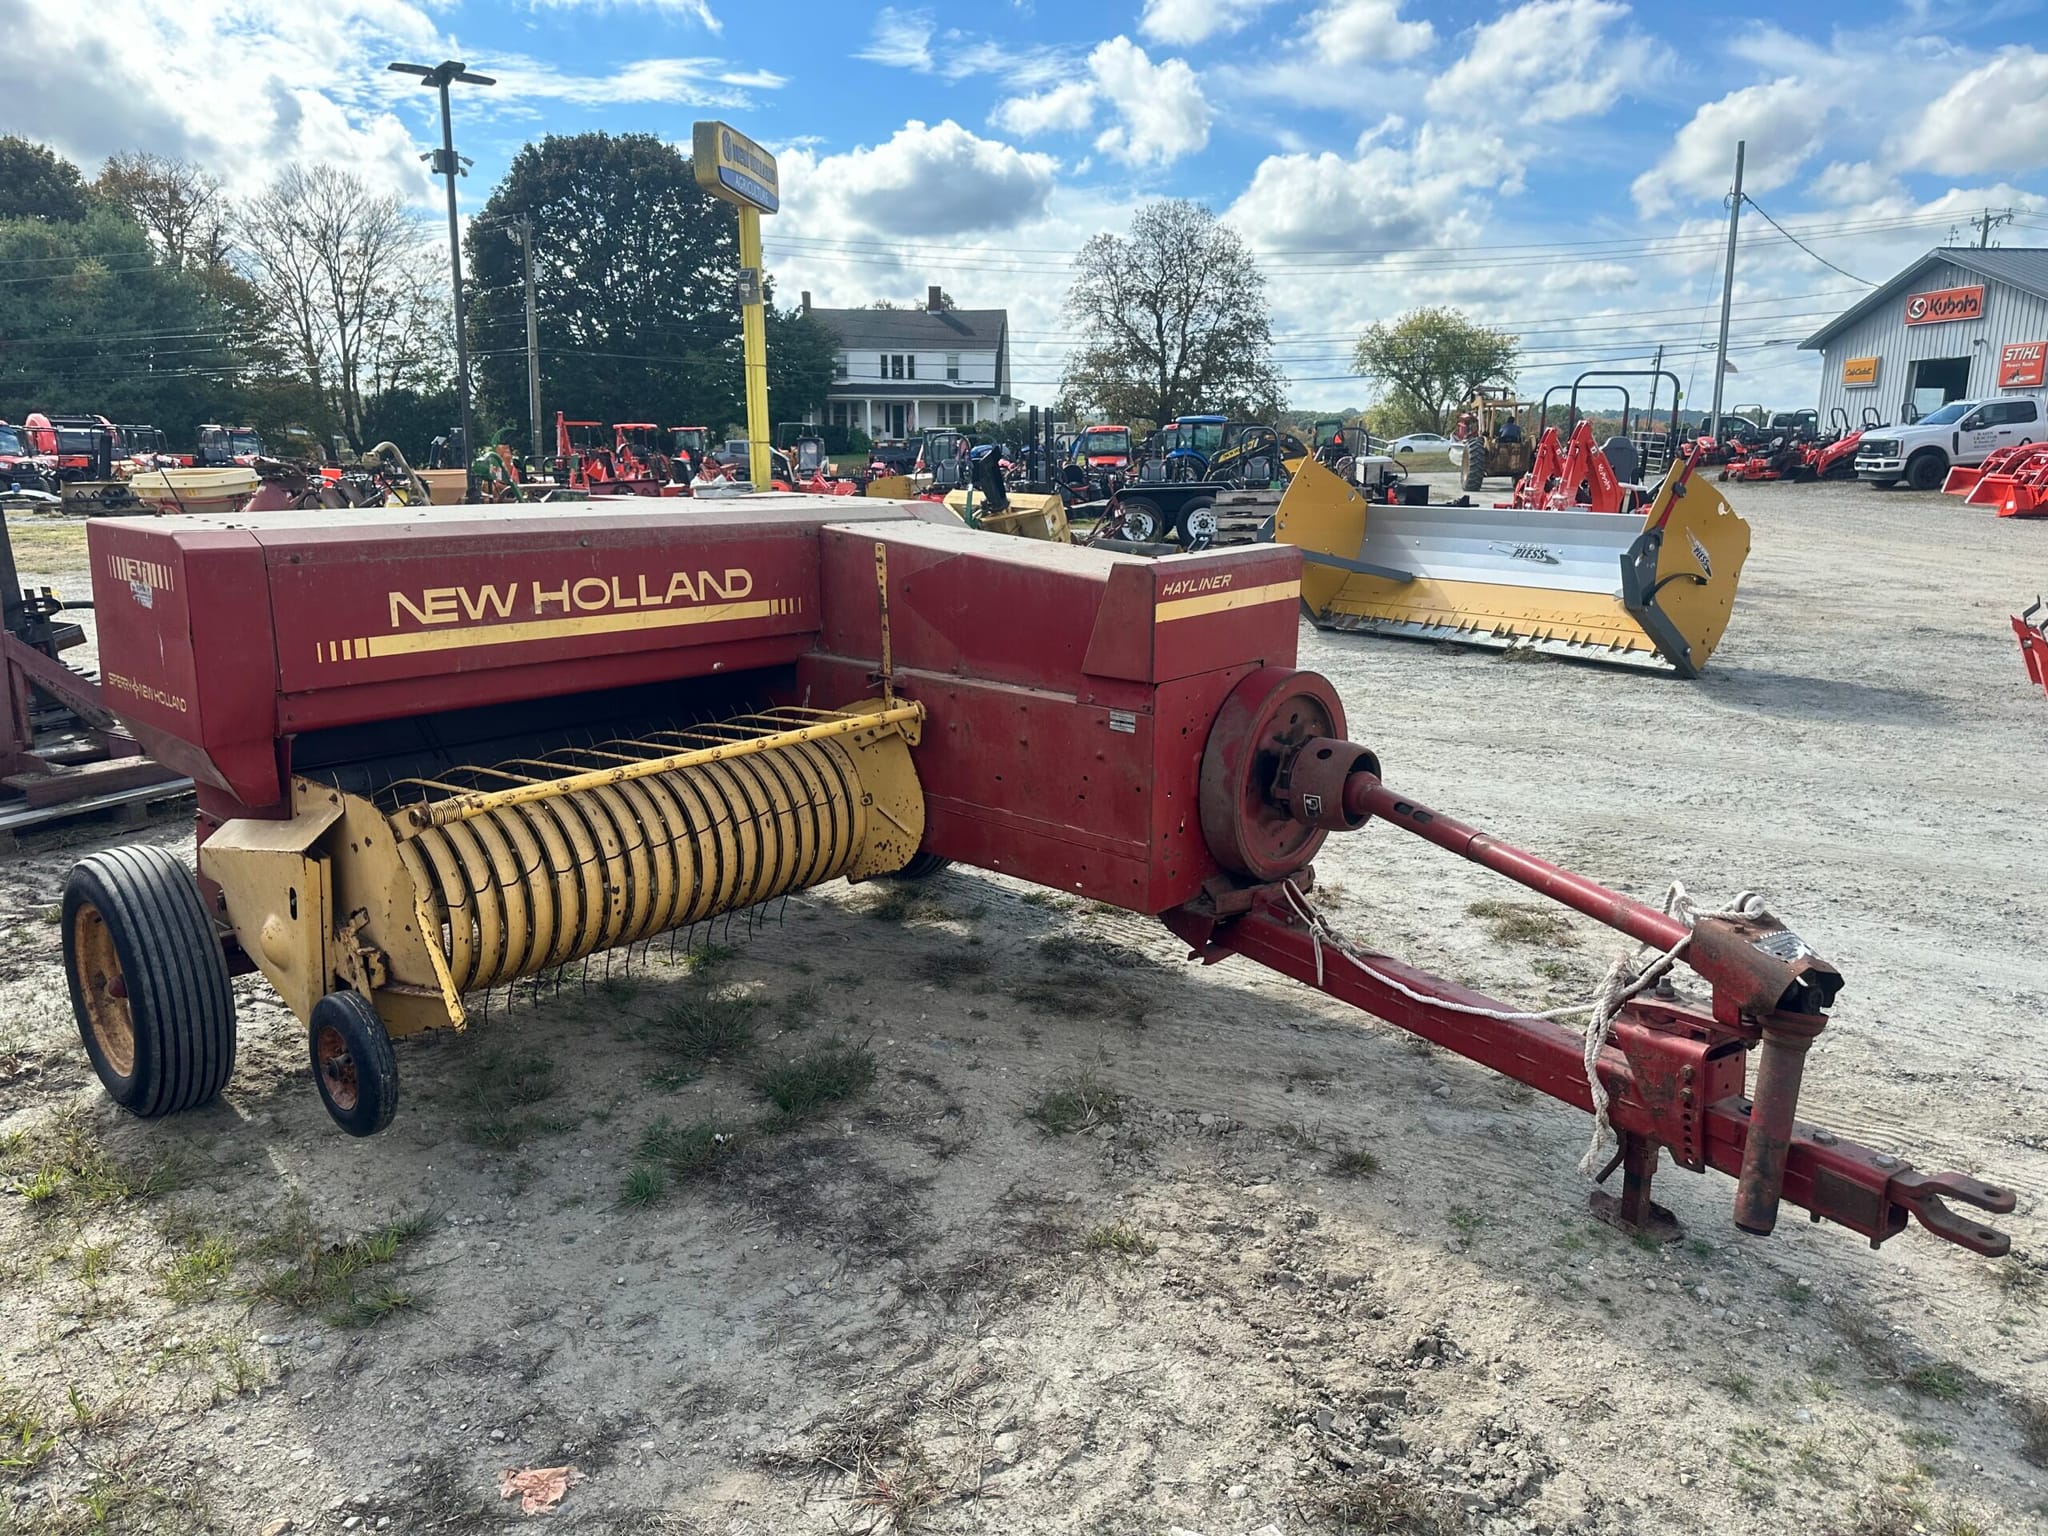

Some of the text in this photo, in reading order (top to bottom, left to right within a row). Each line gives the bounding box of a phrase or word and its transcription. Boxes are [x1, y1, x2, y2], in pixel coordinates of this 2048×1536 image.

[1930, 294, 1978, 315] Kubota
[2003, 346, 2041, 361] STIHL
[1512, 547, 1547, 560] PLESS
[1162, 574, 1233, 596] HAYLINER
[388, 568, 753, 628] NEW HOLLAND
[107, 671, 133, 692] SPERRY
[154, 690, 187, 713] HOLLAND
